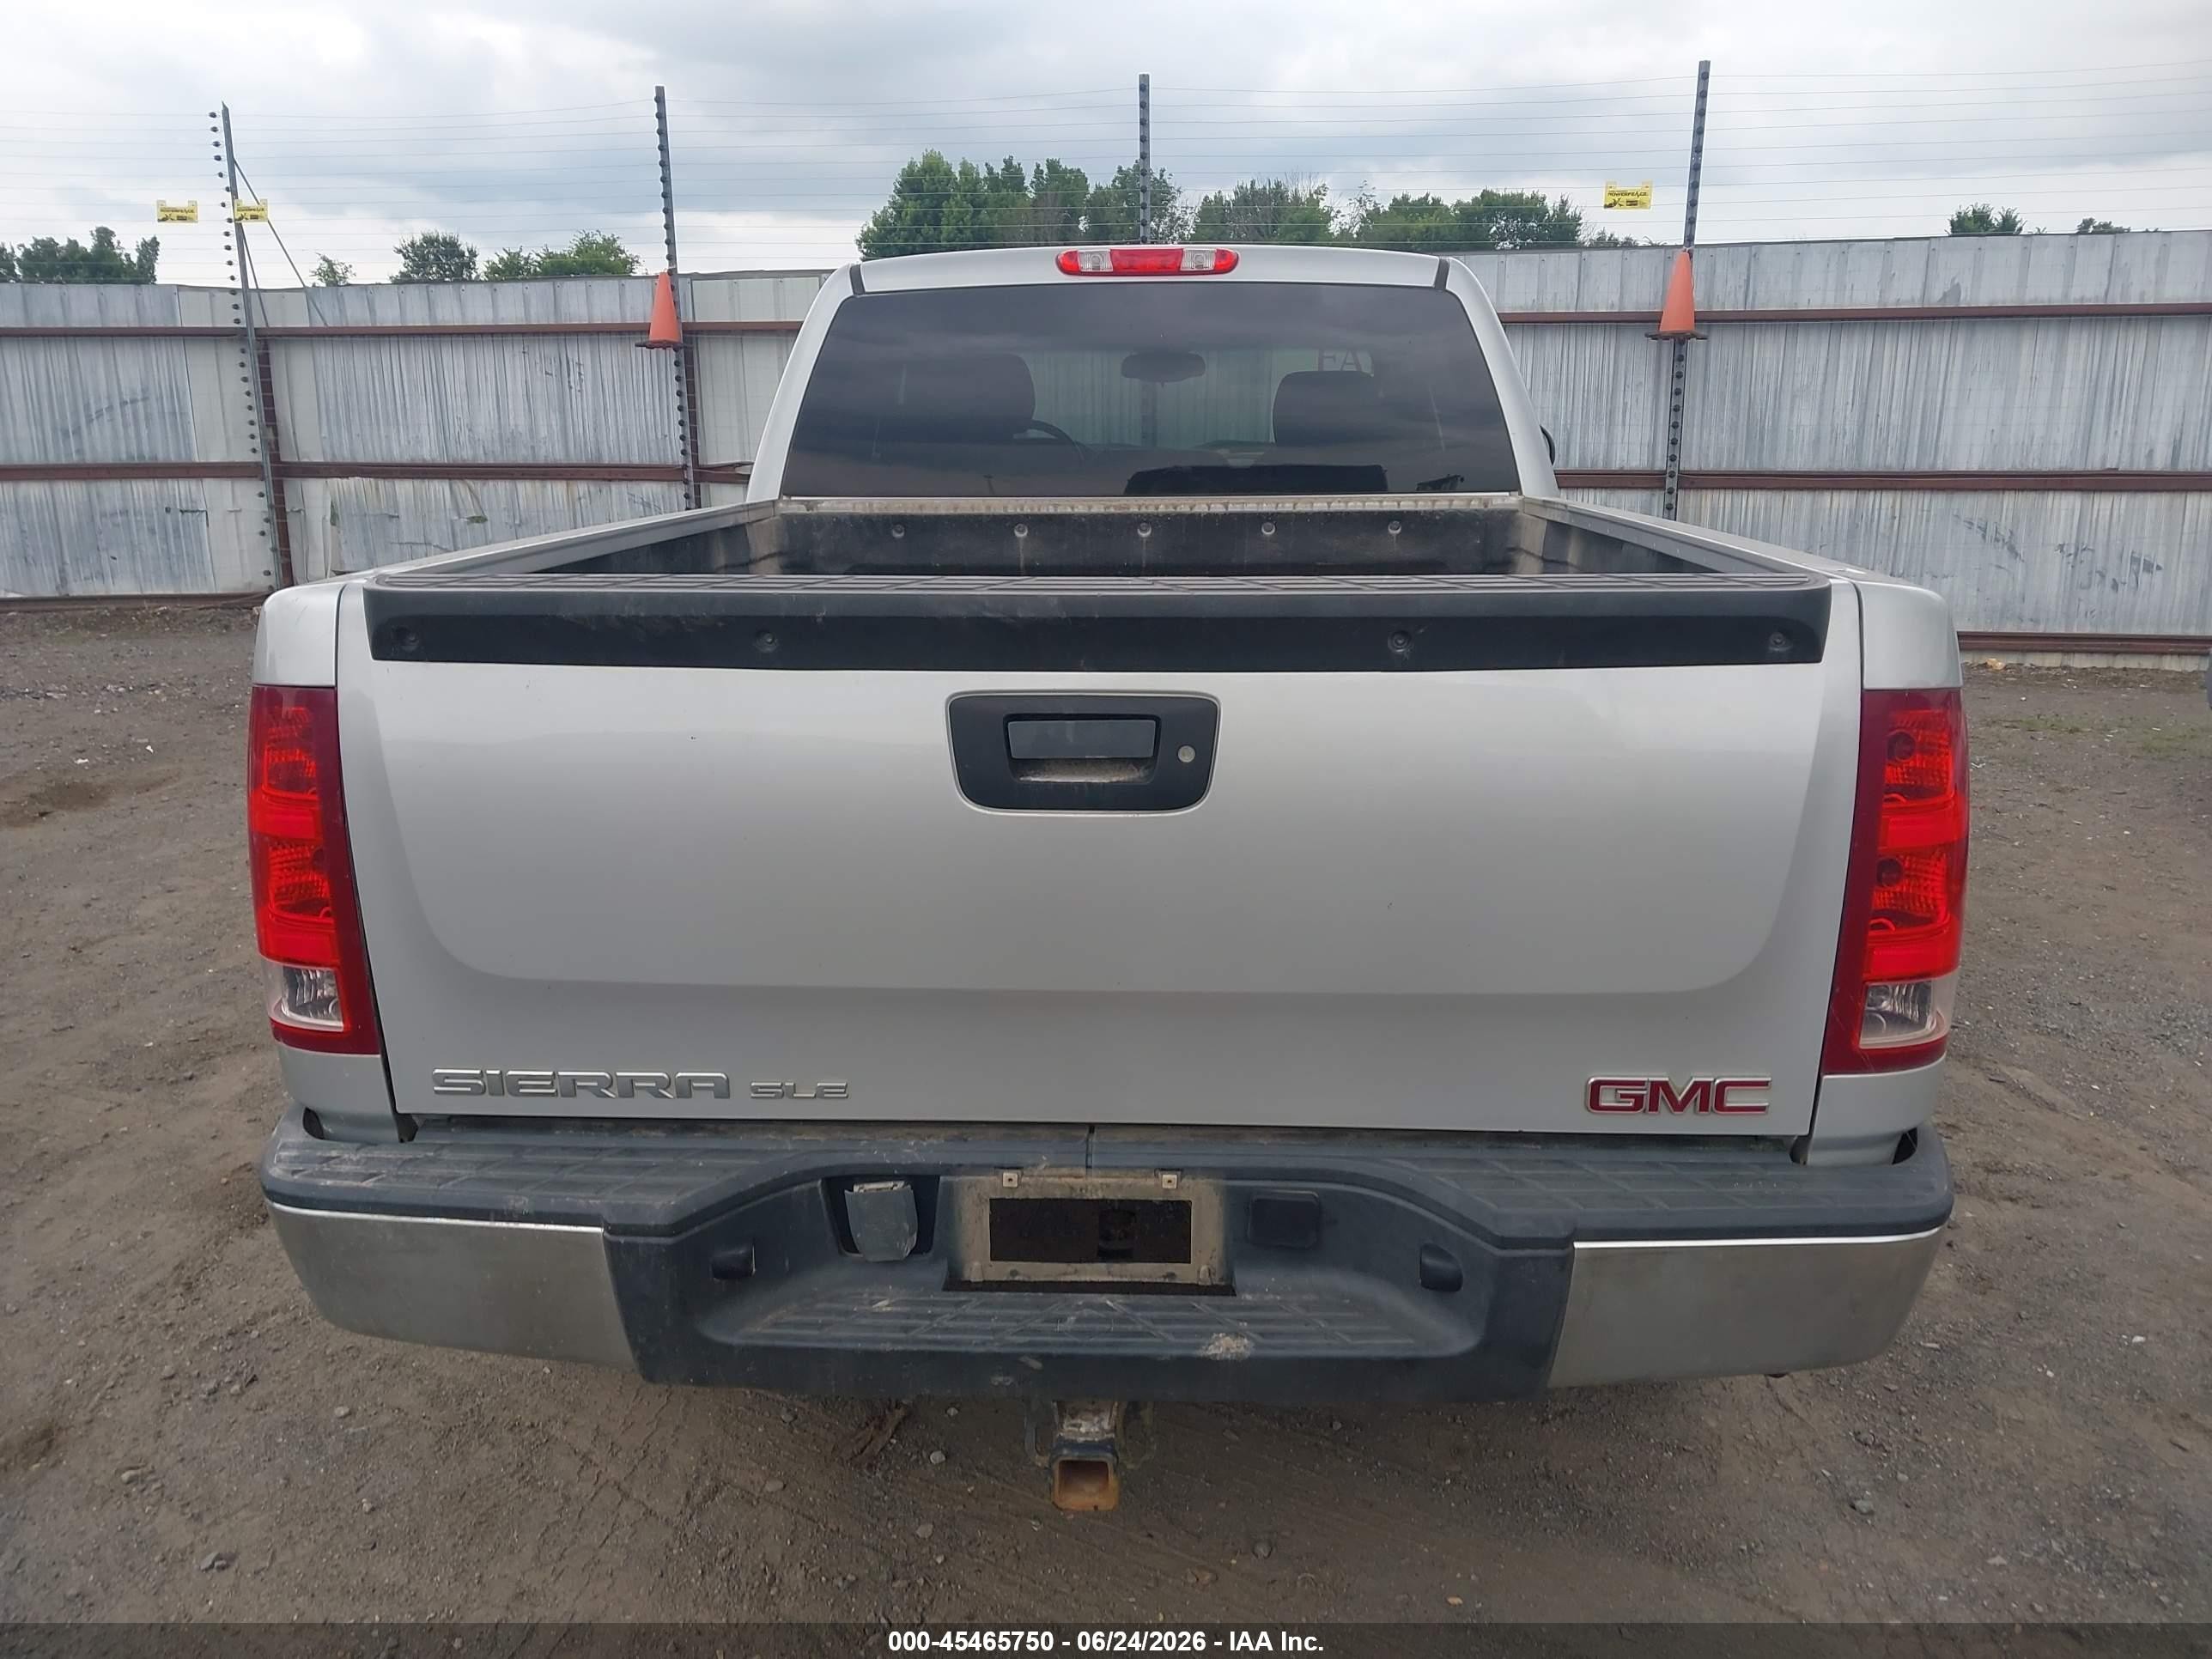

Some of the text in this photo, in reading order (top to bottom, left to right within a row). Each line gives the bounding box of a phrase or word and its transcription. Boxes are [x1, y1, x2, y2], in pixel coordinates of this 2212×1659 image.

[432, 1068, 849, 1100] SIERRA SLE
[1587, 1076, 1772, 1115] GMC
